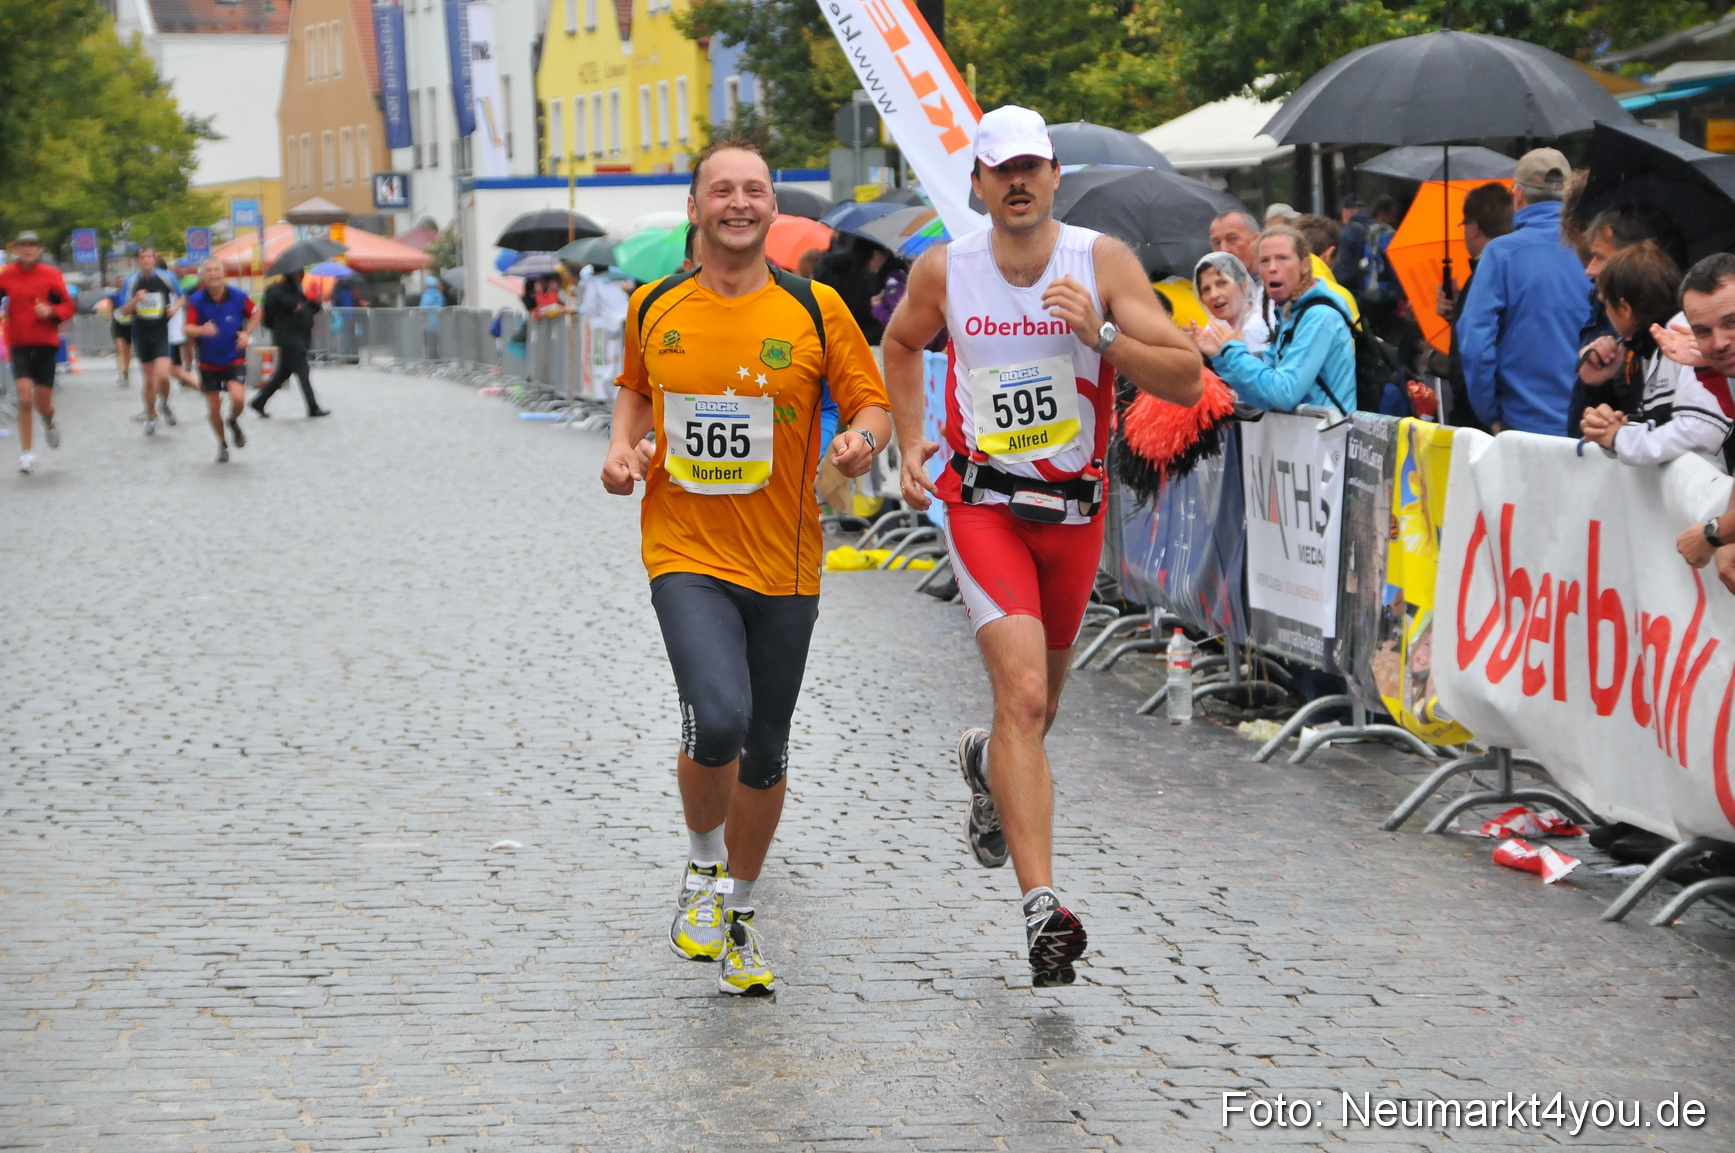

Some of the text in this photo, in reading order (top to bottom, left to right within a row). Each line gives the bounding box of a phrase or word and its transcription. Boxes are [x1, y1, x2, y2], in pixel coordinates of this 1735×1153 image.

[999, 366, 1039, 382] BOCK
[695, 401, 739, 412] BOCK
[992, 385, 1058, 429] 595
[684, 421, 751, 458] 565
[1008, 430, 1048, 450] Alfred
[692, 464, 743, 480] Norbert
[1457, 503, 1720, 769] Oberbank
